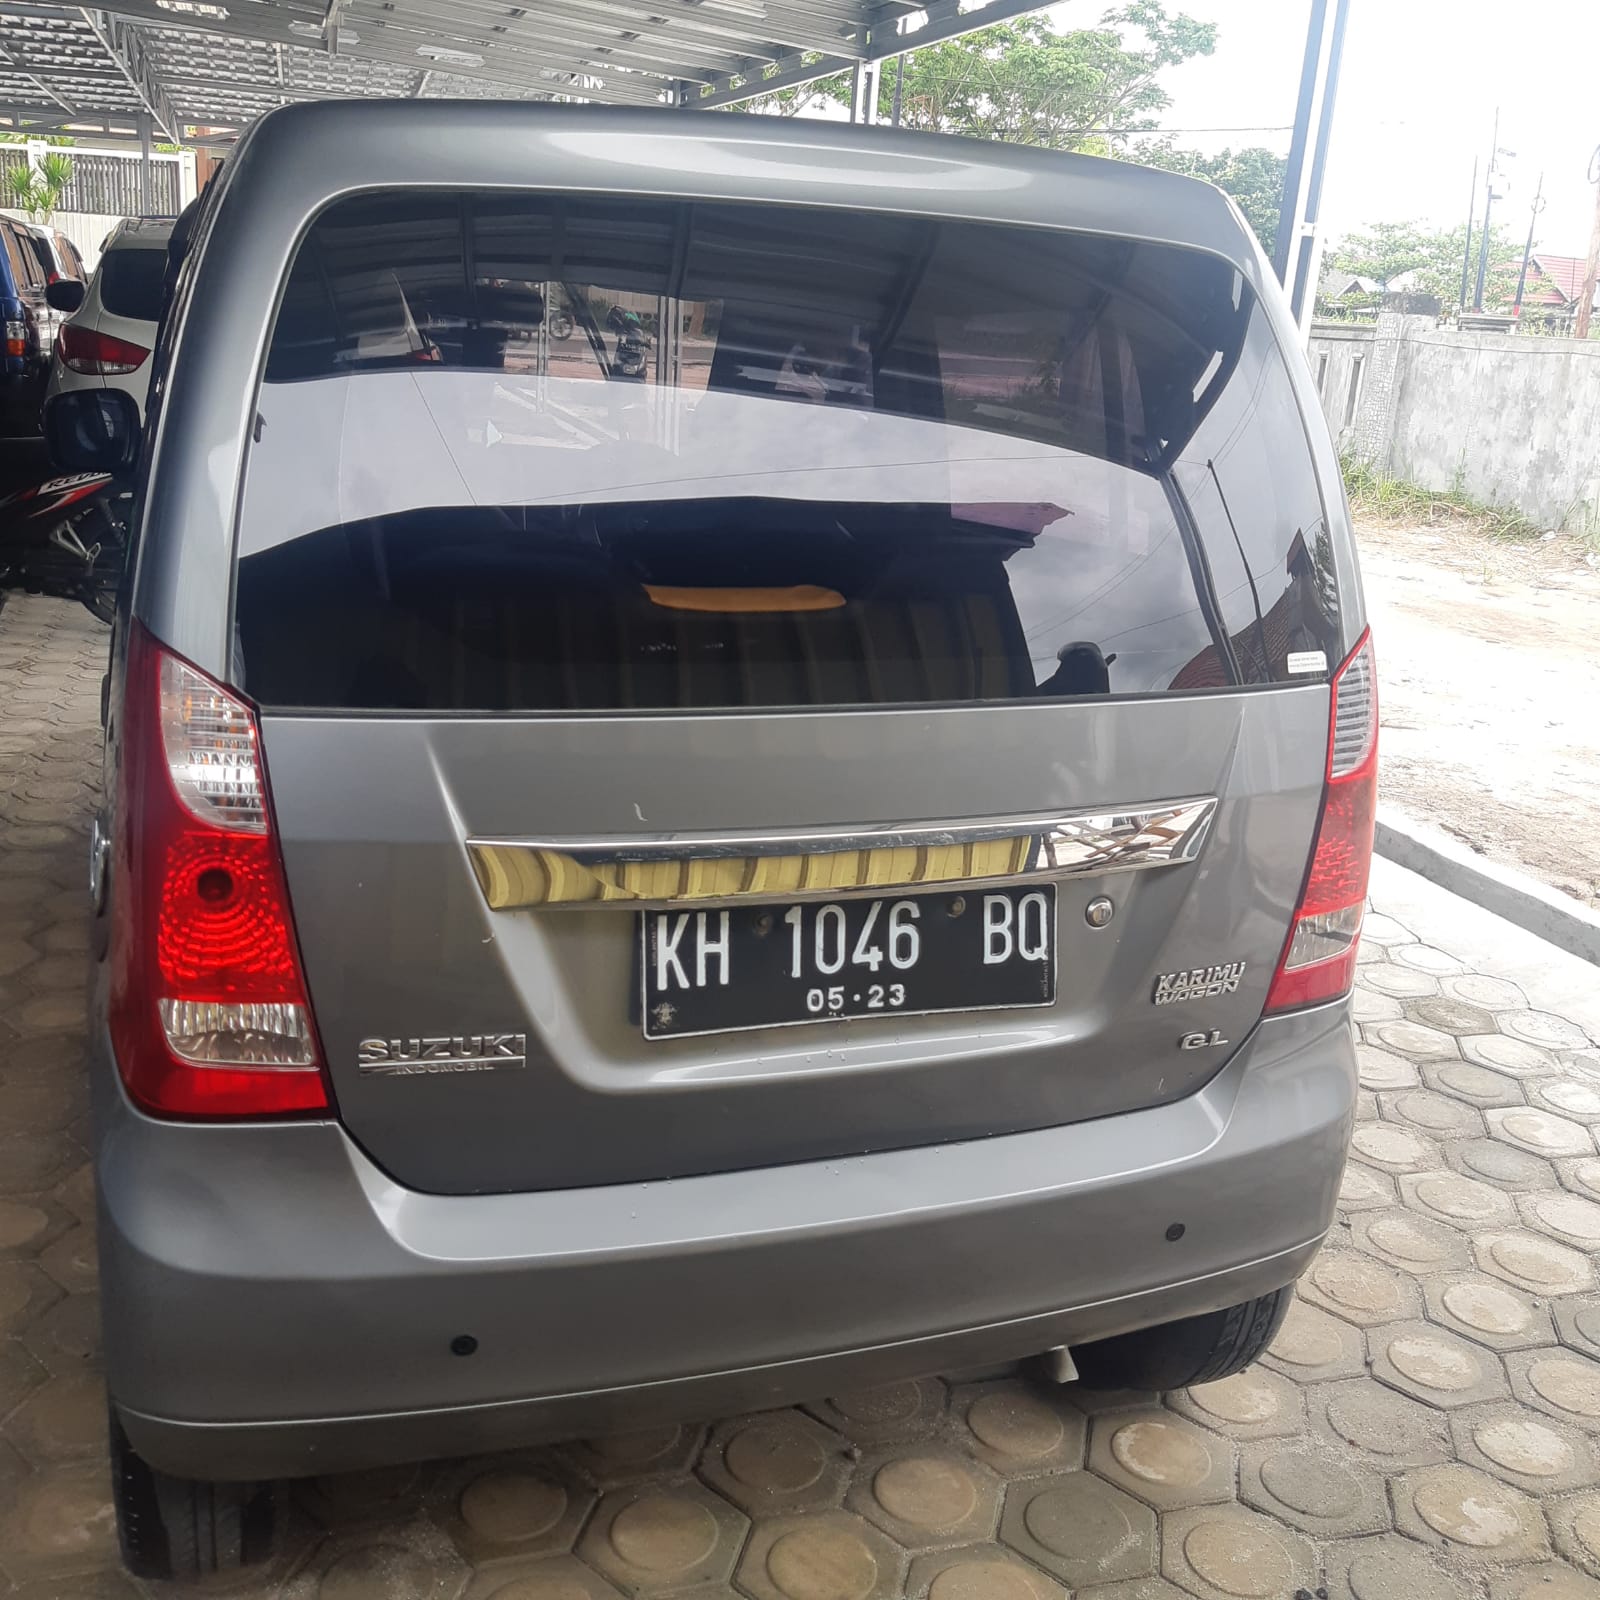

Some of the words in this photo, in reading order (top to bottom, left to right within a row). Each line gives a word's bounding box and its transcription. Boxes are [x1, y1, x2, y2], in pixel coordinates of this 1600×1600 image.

[657, 910, 730, 991] KH
[784, 900, 920, 978] 1046
[983, 893, 1049, 965] BQ
[1156, 961, 1246, 994] KARIMU
[1155, 980, 1240, 1006] WAGON
[358, 1033, 526, 1061] SUZUKI
[1181, 1030, 1229, 1050] GL
[395, 1061, 495, 1075] INDOMOBIL
